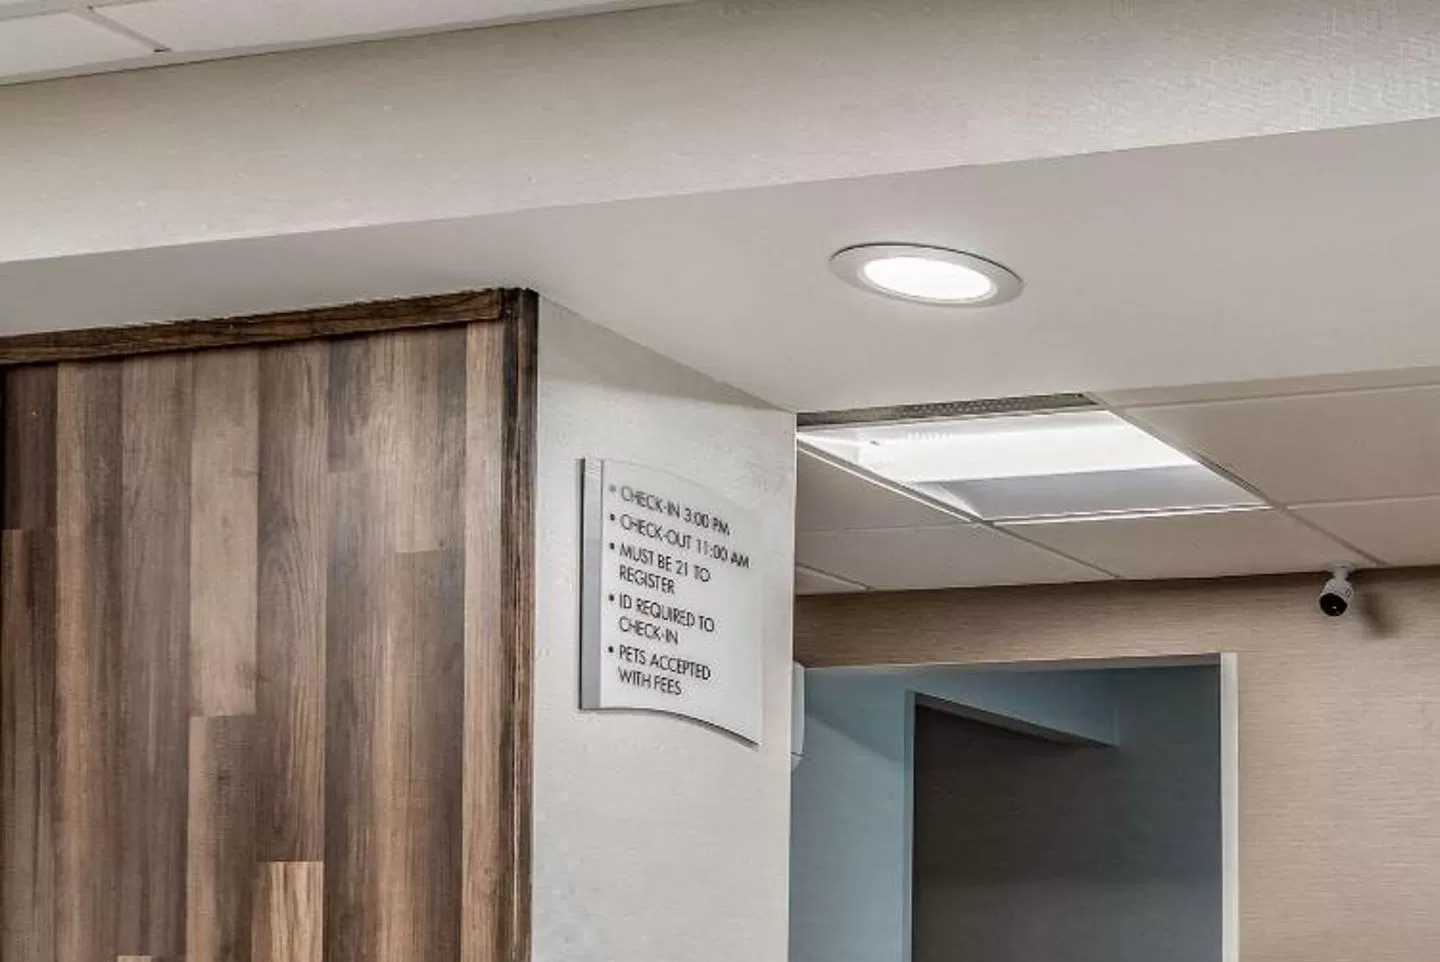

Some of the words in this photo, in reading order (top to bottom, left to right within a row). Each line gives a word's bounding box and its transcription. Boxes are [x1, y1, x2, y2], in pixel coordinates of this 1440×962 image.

[621, 485, 680, 519] CHECK-IN
[685, 508, 709, 528] 3:00
[713, 517, 730, 536] PM
[620, 514, 691, 549] CHECK-OUT
[697, 539, 728, 561] 11:00
[731, 552, 749, 568] AM
[620, 544, 654, 566] MUST
[658, 554, 672, 572] BE
[676, 560, 688, 576] 21
[694, 564, 711, 582] TO
[620, 564, 675, 594] REGISTER
[619, 592, 632, 609] ID
[636, 598, 695, 627] REQUIRED
[698, 615, 715, 632] TO
[619, 616, 678, 645] CHECK-IN
[618, 666, 651, 688] WITH
[654, 675, 682, 695] FEES
[620, 644, 646, 665] PETS
[650, 653, 711, 680] ACCEPTED
